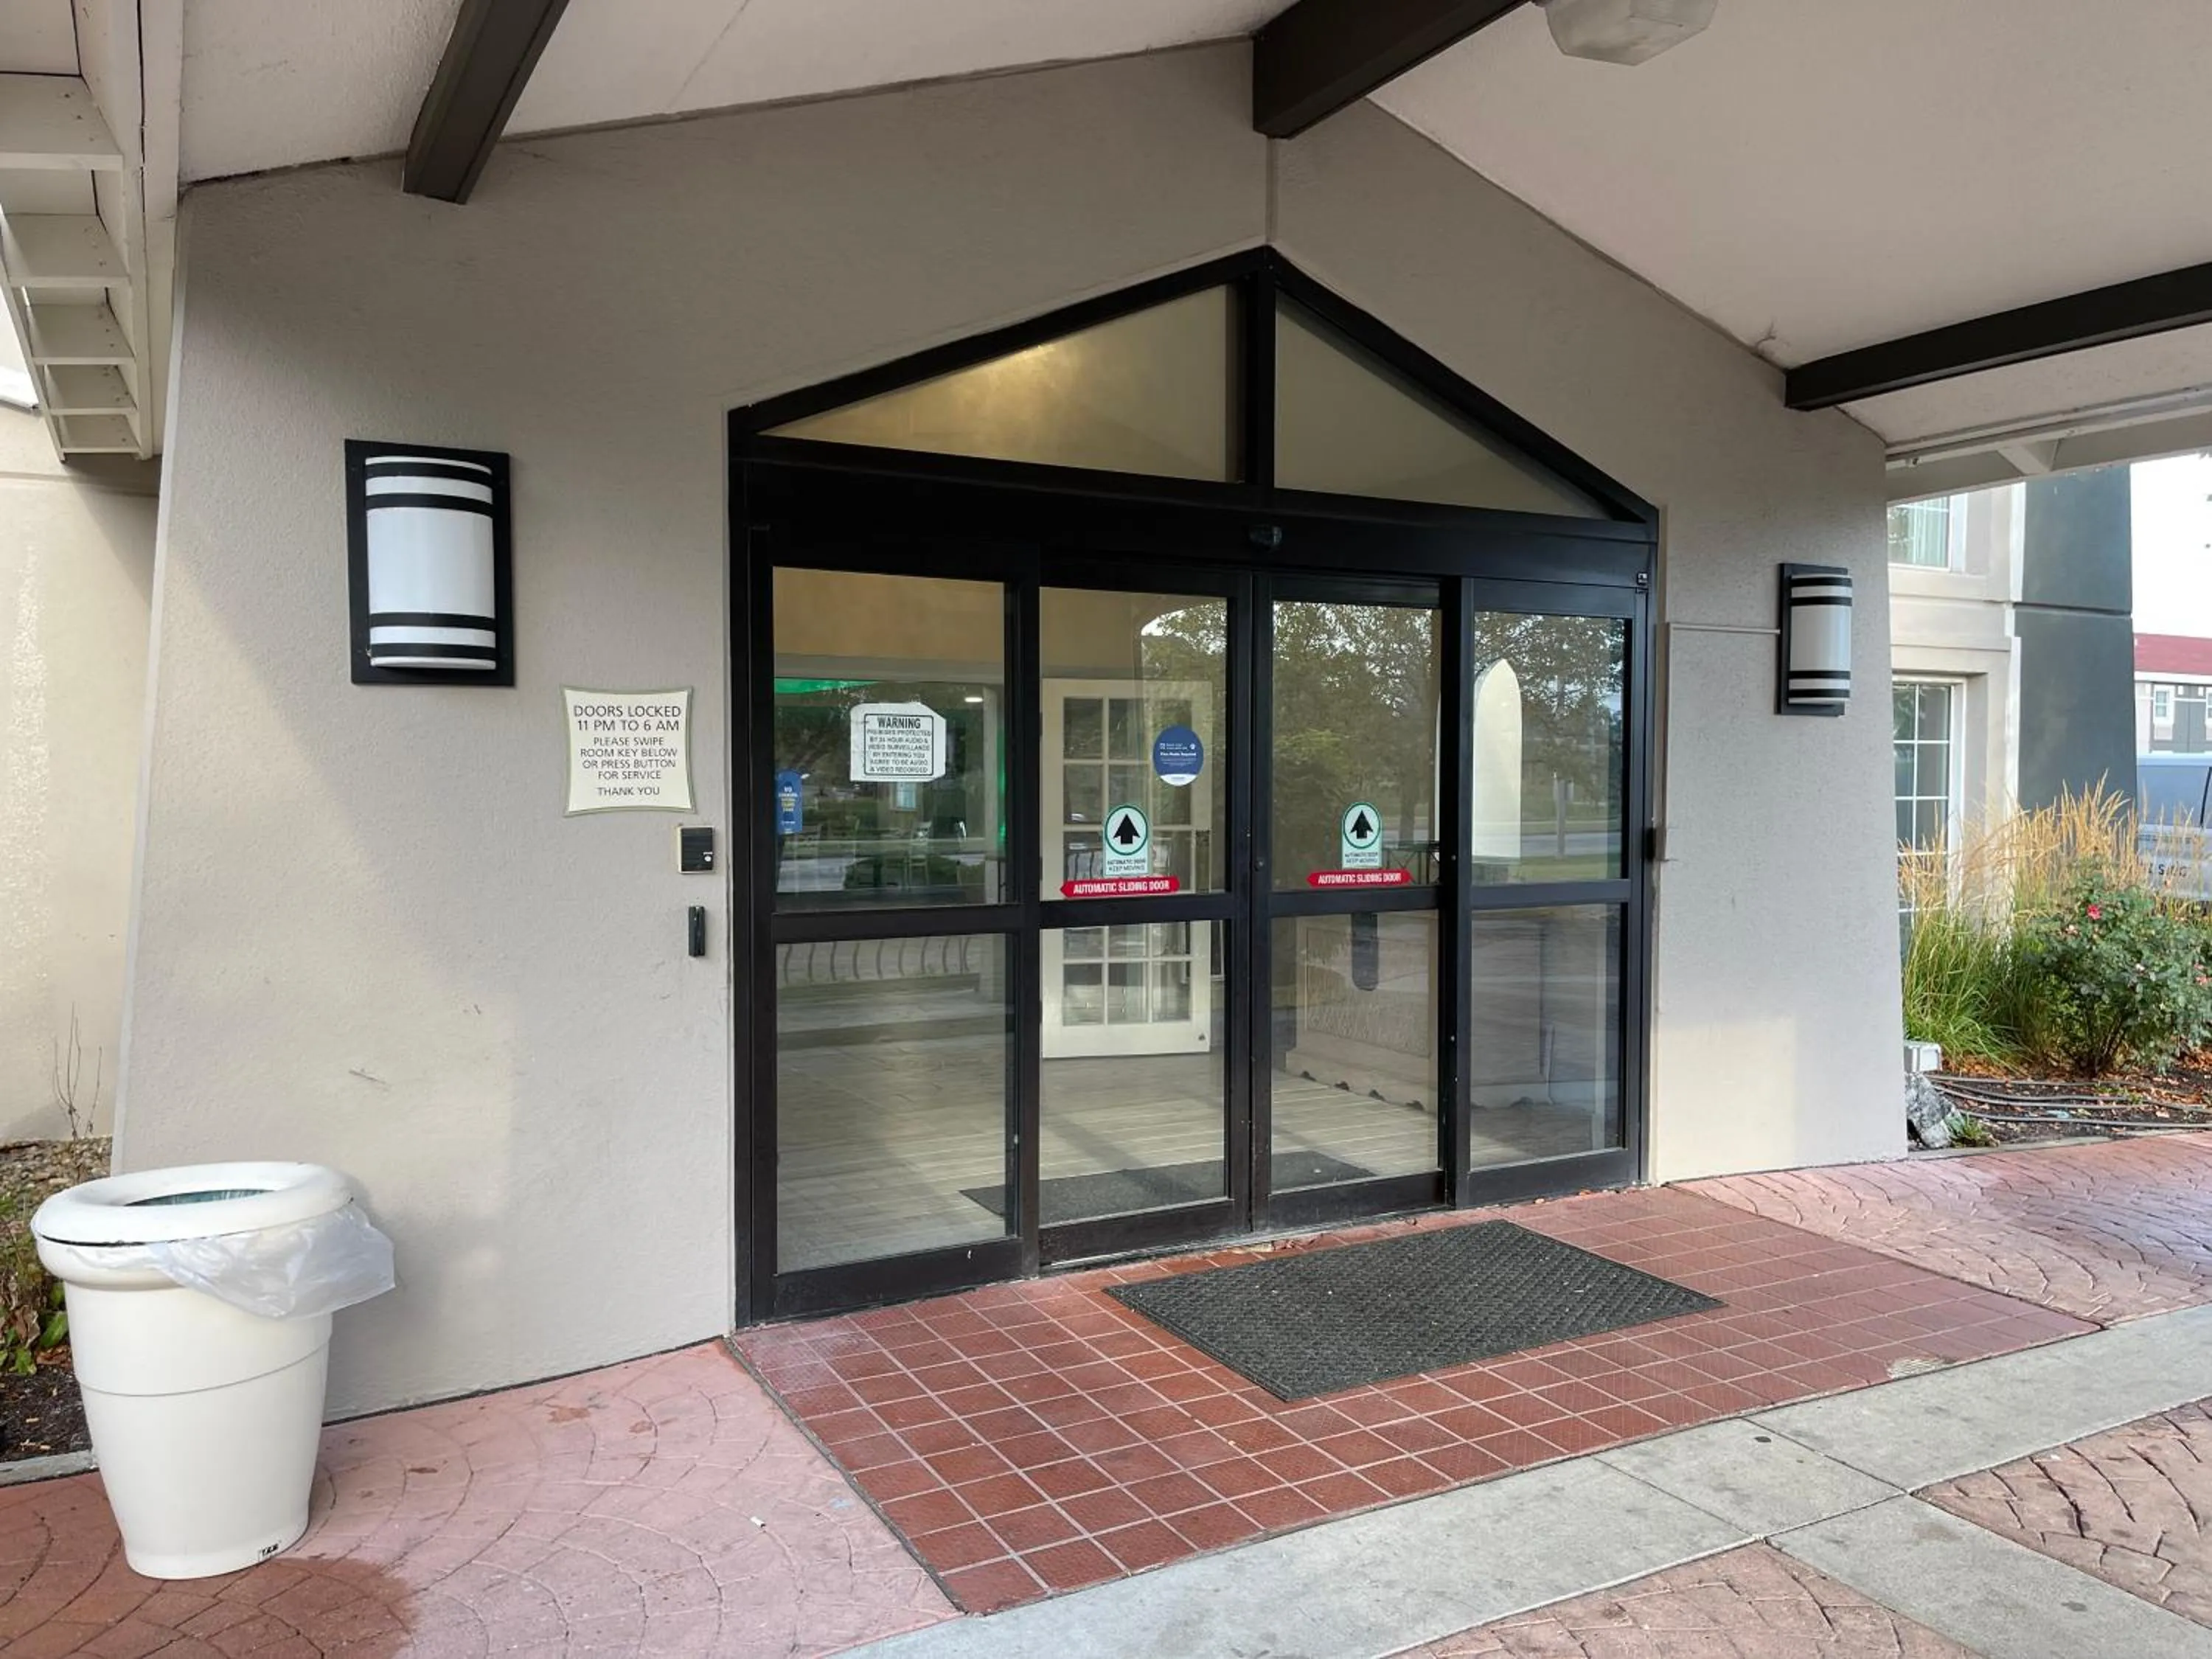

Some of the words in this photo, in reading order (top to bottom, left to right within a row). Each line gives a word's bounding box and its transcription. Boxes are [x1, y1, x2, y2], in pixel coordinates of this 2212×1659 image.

[574, 706, 623, 717] DOORS
[627, 706, 681, 717] LOCKED
[578, 720, 588, 731] 11
[594, 720, 616, 731] PM
[621, 720, 639, 731] TO
[644, 720, 651, 731] 6
[655, 720, 679, 731] AM
[877, 717, 920, 728] WARNING
[594, 737, 630, 746] PLEASE
[633, 737, 664, 746] SWIPE
[580, 748, 614, 757] ROOM
[617, 748, 638, 757] KEY
[641, 748, 678, 757] BELOW
[582, 759, 598, 768] OR
[601, 759, 630, 768] PRESS
[633, 759, 676, 768] BUTTON
[598, 771, 619, 779] FOR
[622, 771, 661, 779] SERVICE
[597, 787, 634, 796] THANK
[638, 787, 660, 795] YOU
[1318, 873, 1356, 884] AUTOMATIC
[1357, 873, 1382, 883] SLIDING
[1383, 872, 1401, 882] DOOR
[1074, 882, 1116, 894] AUTOMATIC
[1119, 881, 1147, 892] SLIDING
[1149, 880, 1169, 890] DOOR
